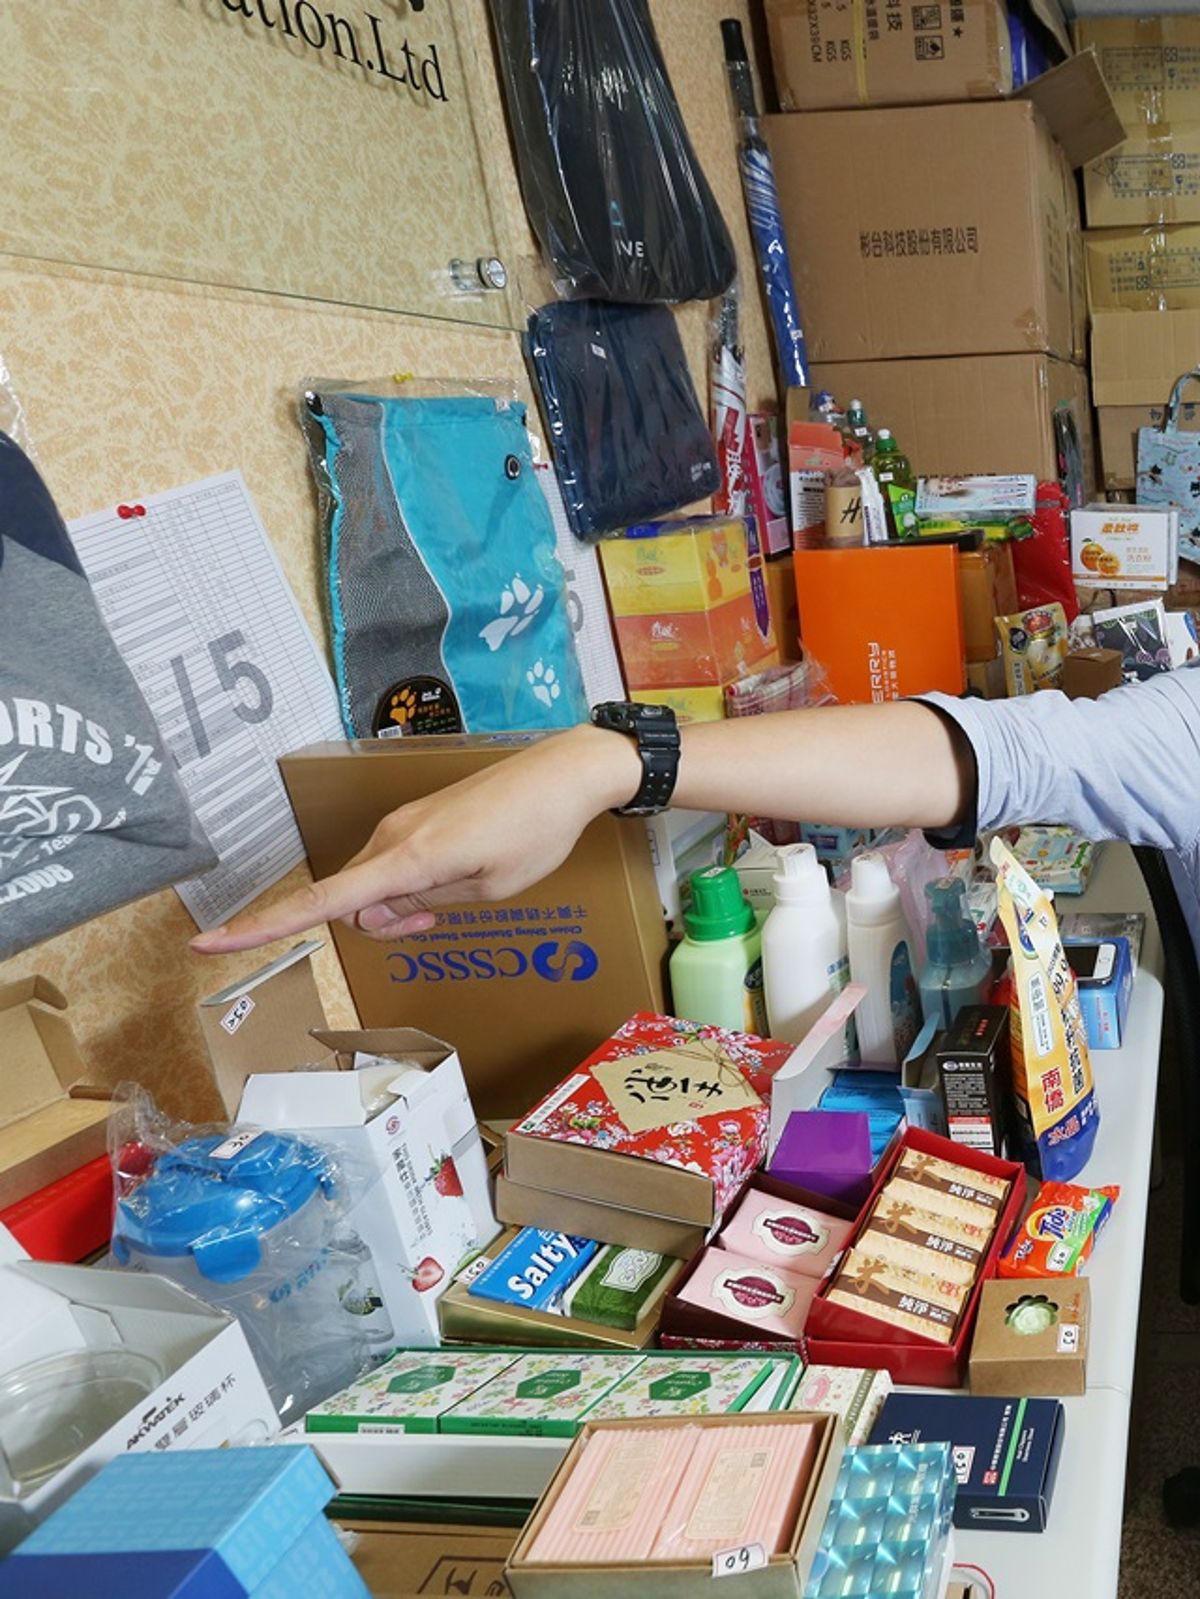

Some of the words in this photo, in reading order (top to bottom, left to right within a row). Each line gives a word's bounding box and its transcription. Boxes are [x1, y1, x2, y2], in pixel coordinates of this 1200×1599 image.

[170, 629, 274, 760] /5
[429, 931, 460, 942] Steel
[388, 947, 528, 984] CSSSC
[1038, 1207, 1068, 1240] Tide
[506, 1232, 578, 1300] Salty
